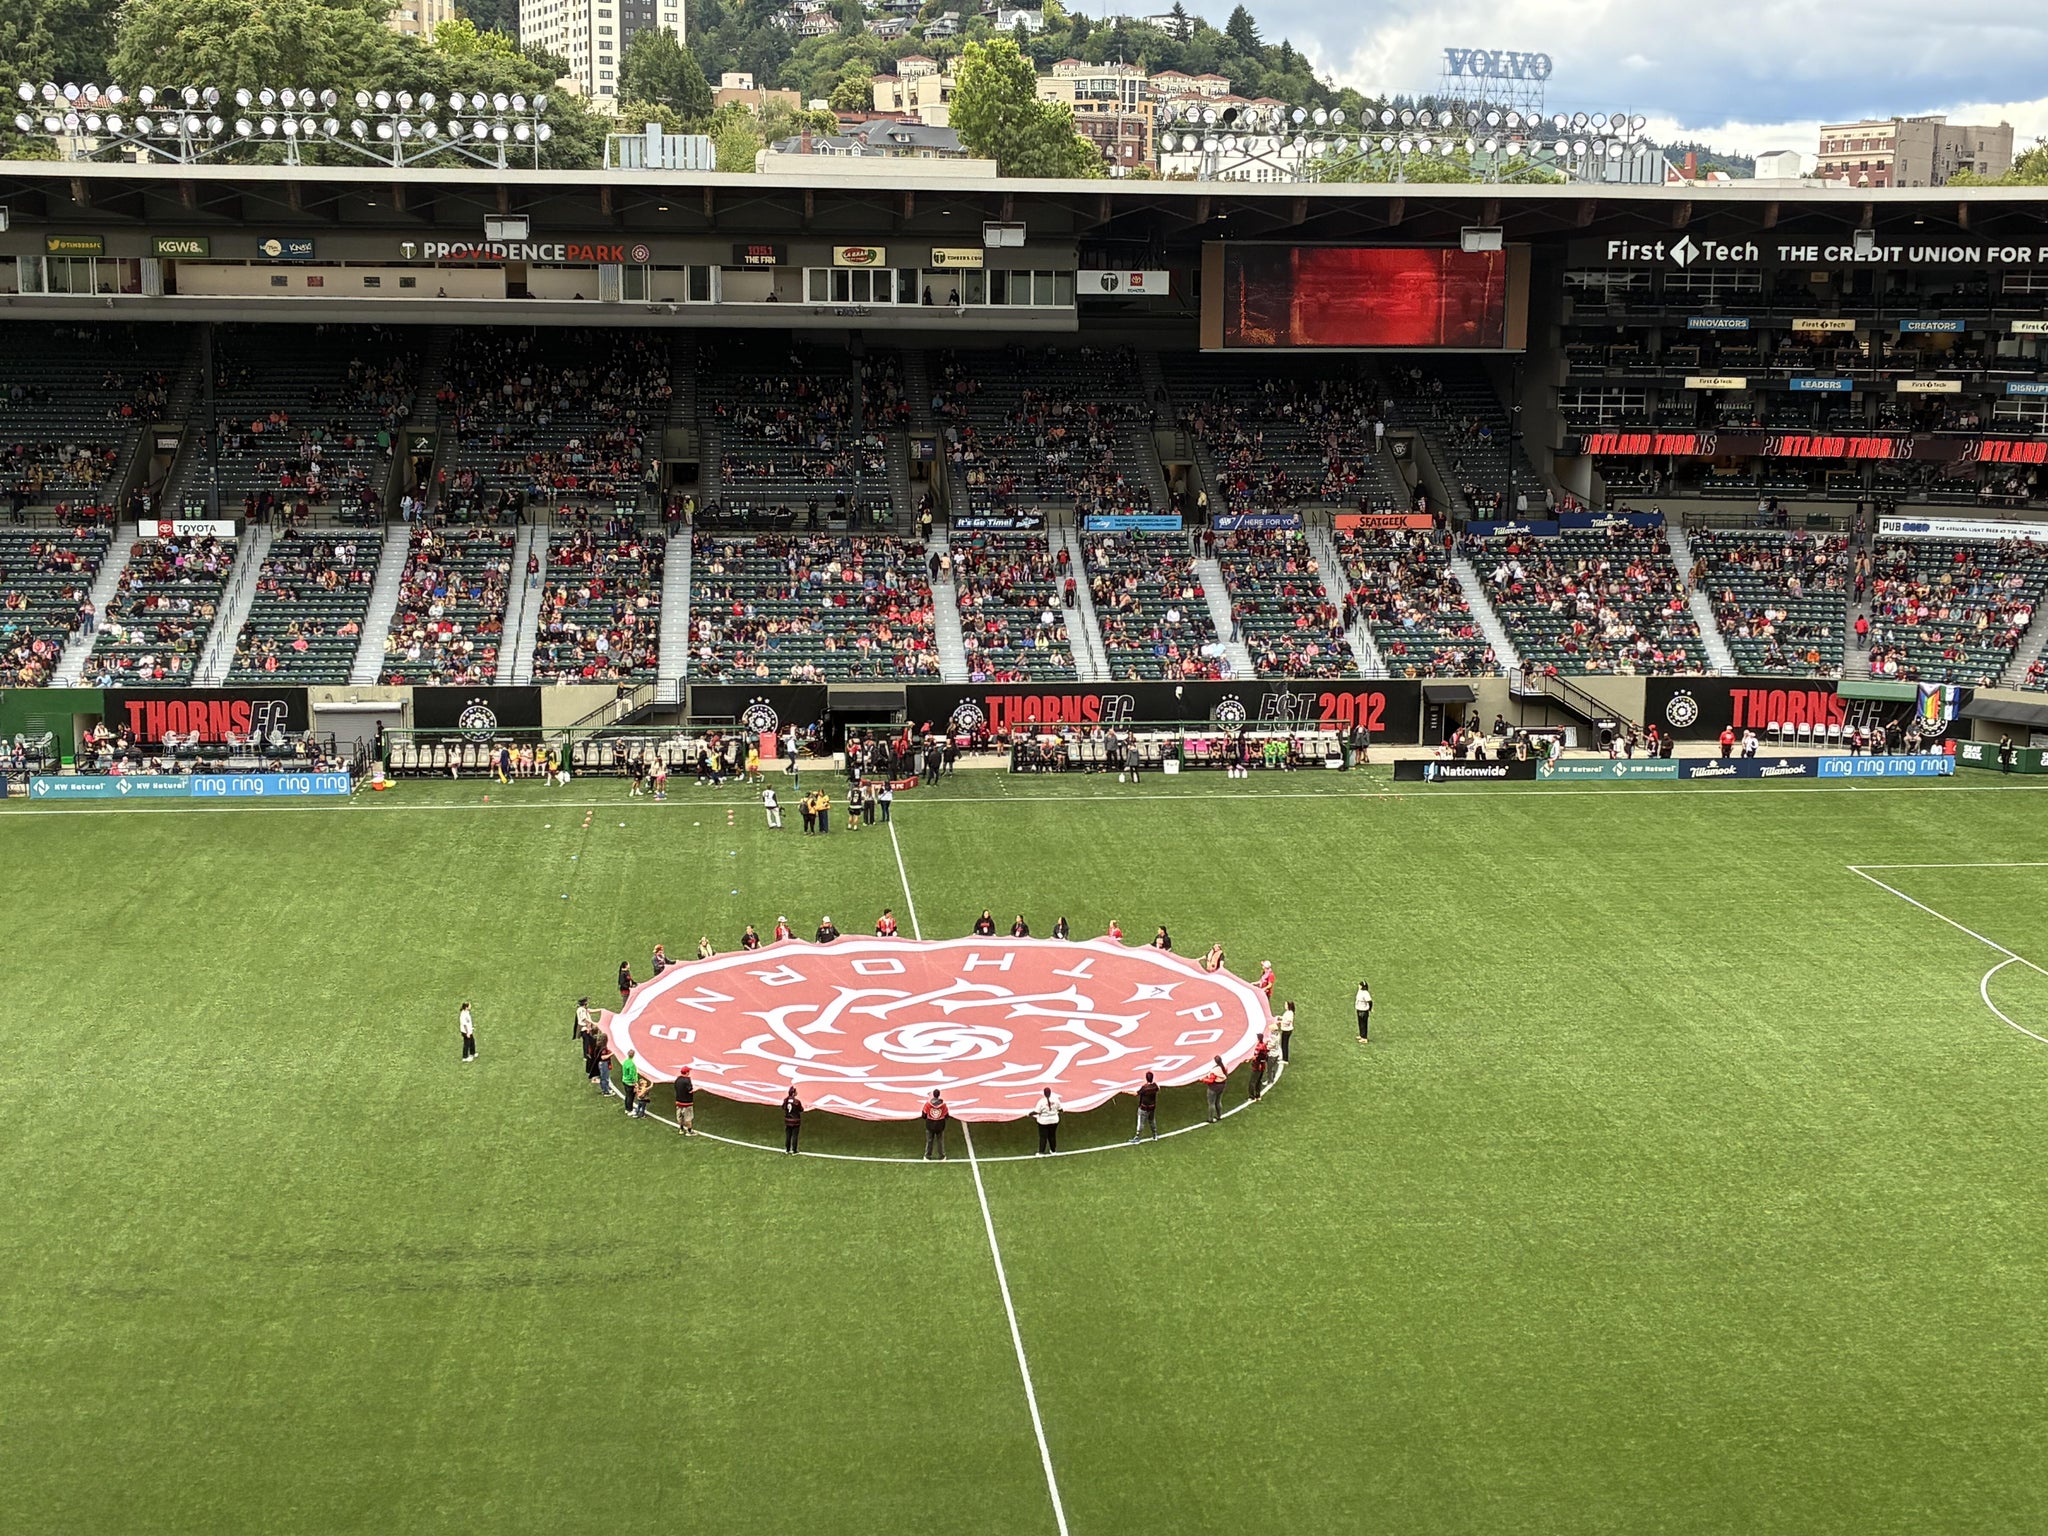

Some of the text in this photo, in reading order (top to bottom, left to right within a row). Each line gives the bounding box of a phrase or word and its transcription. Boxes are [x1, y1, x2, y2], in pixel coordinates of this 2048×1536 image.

[1444, 48, 1553, 80] VOLVO
[424, 242, 625, 261] PROVIDENCE PARK
[1607, 240, 1759, 261] First Tech
[1777, 246, 1819, 261] THE
[1823, 246, 1903, 262] CREDIT
[1908, 247, 1980, 262] UNION
[1987, 247, 2031, 262] FOR
[744, 256, 776, 264] THE FAN
[1689, 319, 1748, 328] INNOVATORS
[1908, 322, 1957, 330] CREATORS
[1800, 380, 1842, 390] LEADERS
[1762, 436, 1914, 460] PORTLAND THORNS
[1959, 440, 2048, 463] PORTLAND
[957, 518, 972, 526] It's
[973, 518, 986, 526] Go
[1360, 516, 1407, 527] SEATGEEK
[1591, 518, 1629, 528] Tillamook
[1882, 522, 1901, 531] PUB
[1493, 524, 1530, 536] Tillamook
[985, 695, 1101, 735] THORNS
[1319, 692, 1386, 731] 2012
[1729, 689, 1847, 729] THORNS
[125, 700, 289, 742] THORNS FC
[1963, 745, 1983, 753] SEAT
[1440, 766, 1508, 777] Nationwide
[1690, 765, 1737, 778] Tillamook
[1760, 764, 1806, 778] Tillamook
[1825, 758, 1947, 776] ring ring ring ring
[70, 782, 106, 791] Natural
[152, 781, 187, 790] Natural
[194, 776, 264, 795] ring ring
[278, 774, 347, 793] ring ring
[649, 952, 1095, 1044] THORNS
[785, 1103, 793, 1114] 9
